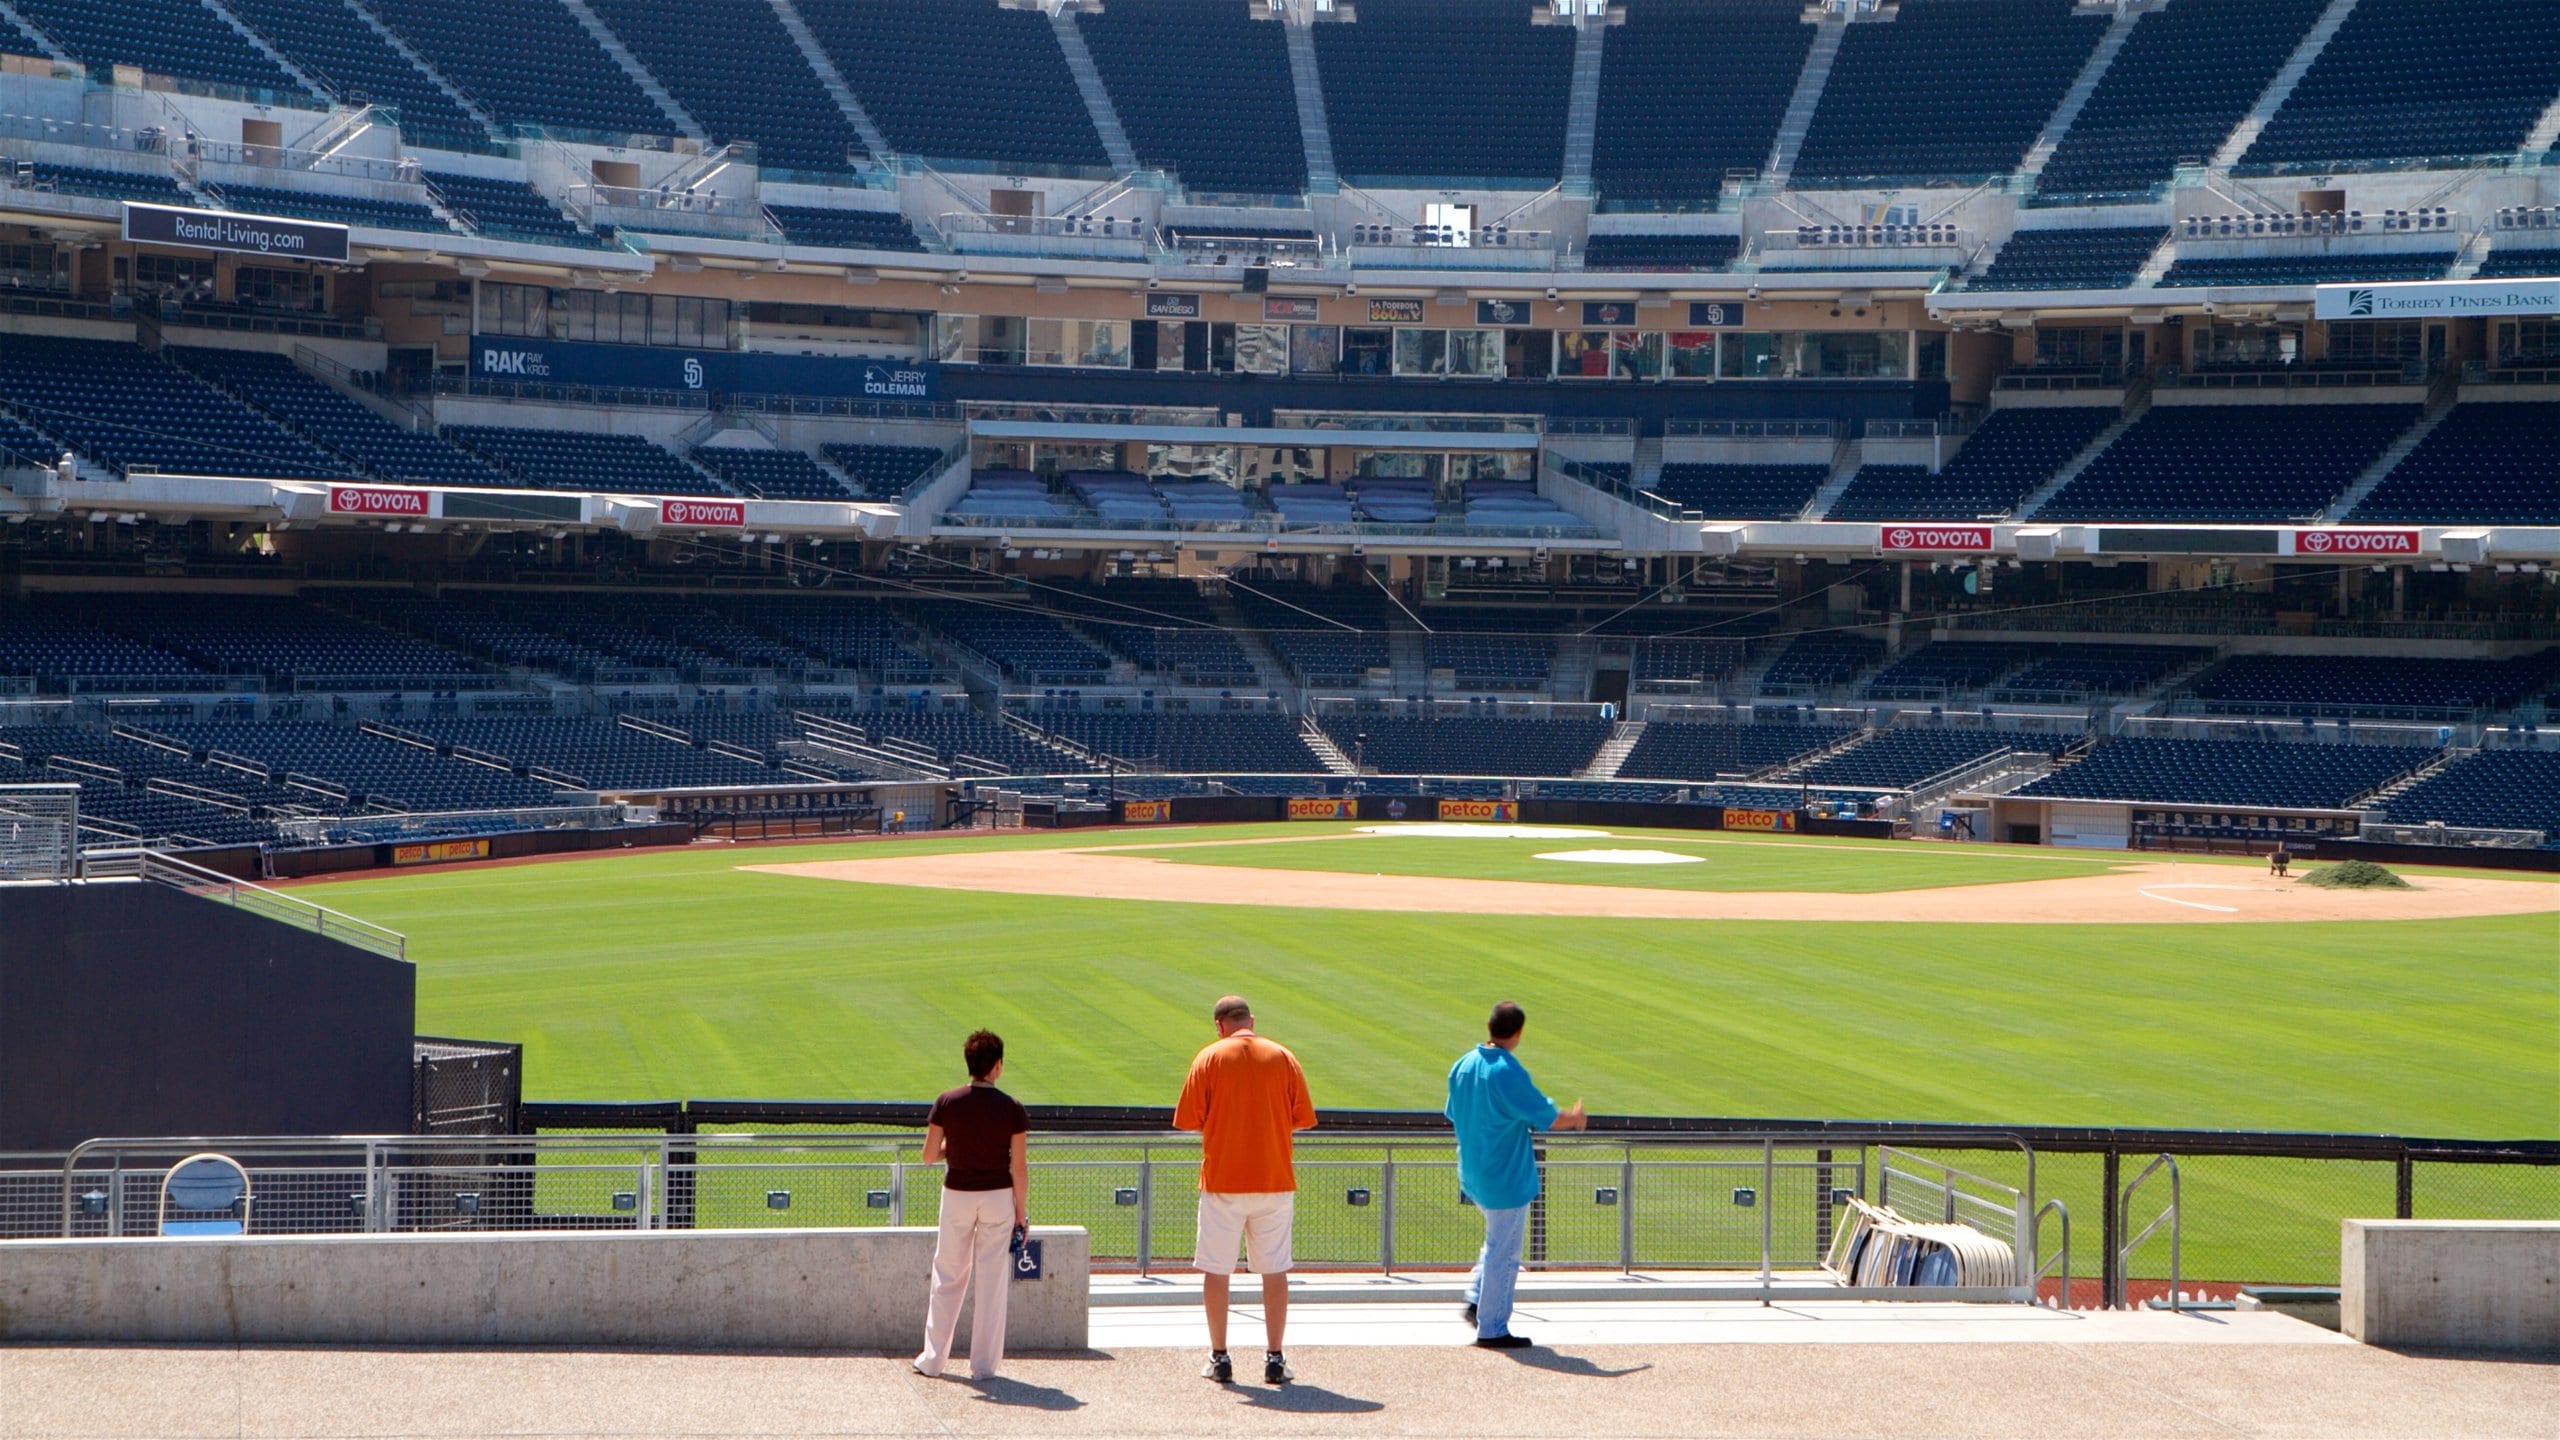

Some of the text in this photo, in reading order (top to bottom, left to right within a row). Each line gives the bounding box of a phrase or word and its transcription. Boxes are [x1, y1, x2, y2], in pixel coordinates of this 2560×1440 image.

[175, 216, 304, 251] Rental-Living.com
[1150, 304, 1194, 315] SAN DIEGO
[2377, 293, 2554, 310] TORREY PINES BANK
[484, 349, 526, 374] RAK
[526, 352, 543, 364] RAY
[526, 364, 550, 376] KROC
[890, 370, 927, 383] JERRY
[864, 382, 926, 396] COLEMAN
[363, 493, 421, 511] TOYOTA
[689, 505, 739, 522] TOYOTA
[1916, 531, 1984, 546] TOYOTA
[2334, 534, 2410, 550] TOYOTA
[1289, 801, 1335, 820] petco
[1440, 803, 1492, 820] petco
[1726, 812, 1773, 828] petco
